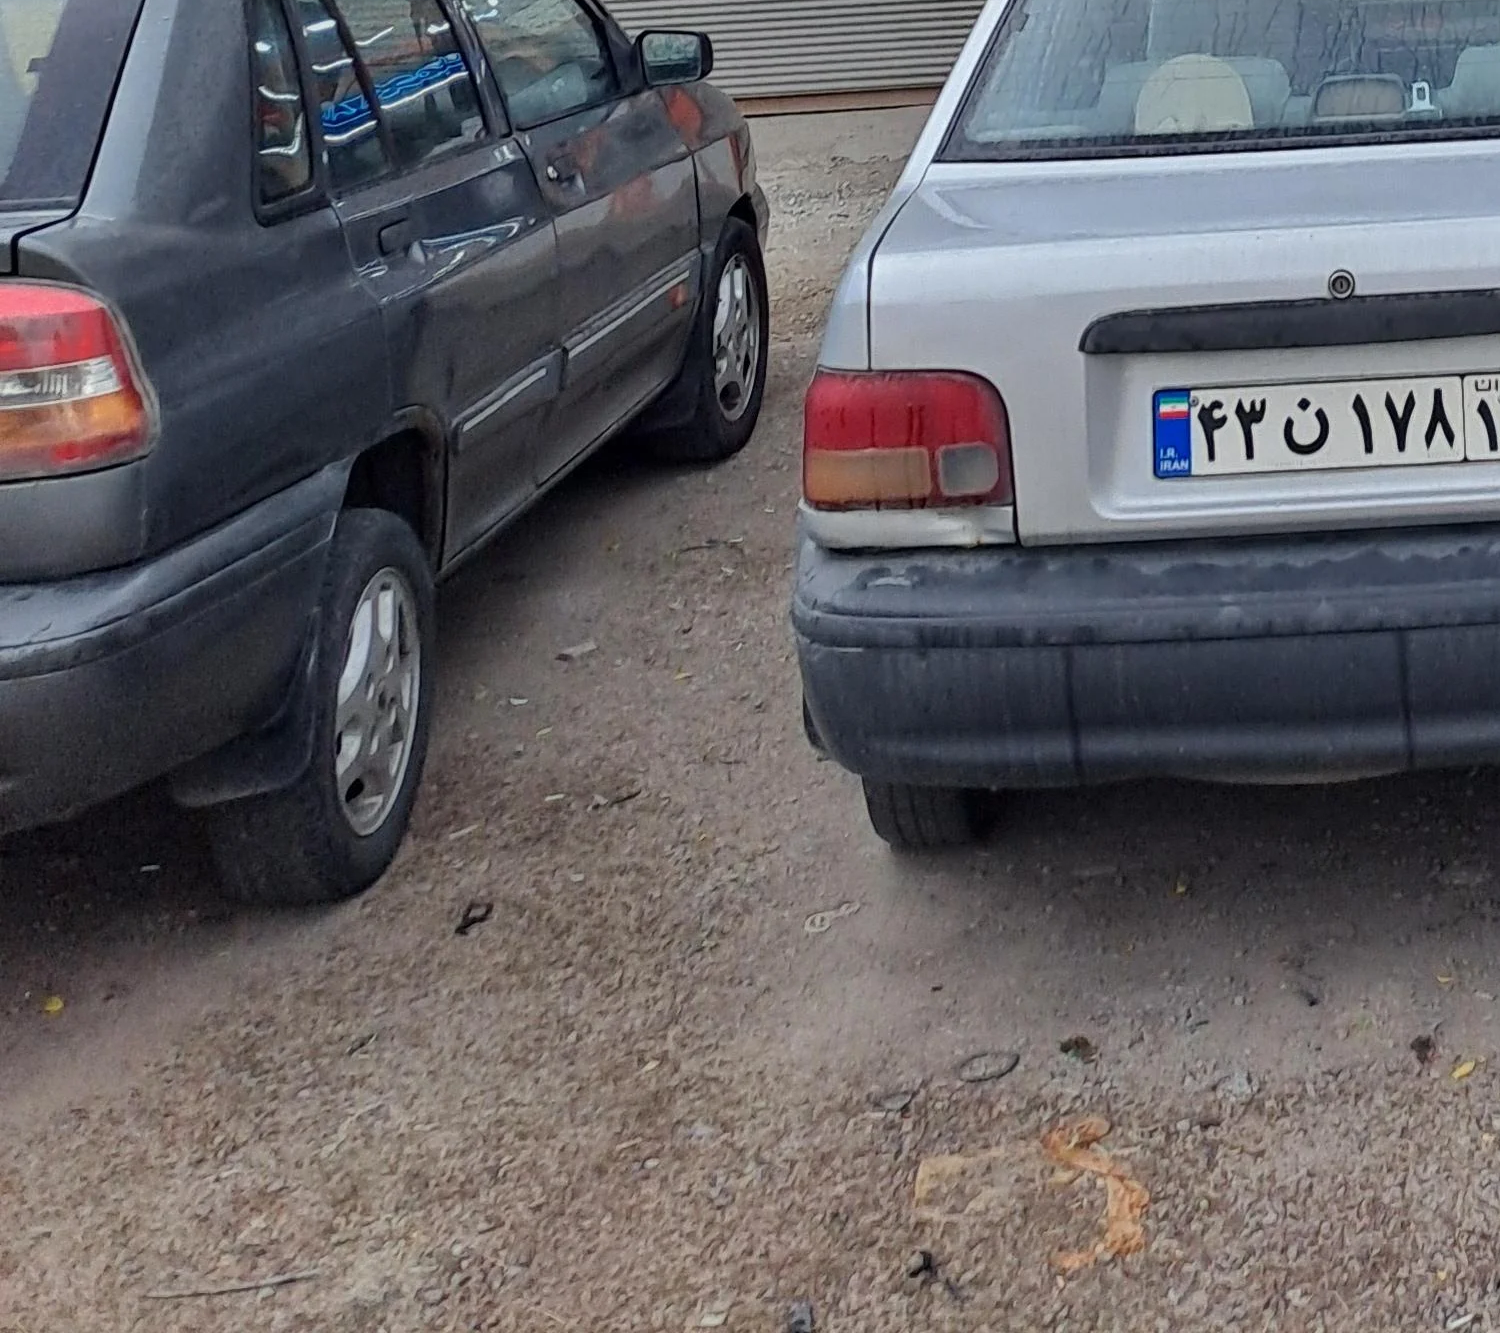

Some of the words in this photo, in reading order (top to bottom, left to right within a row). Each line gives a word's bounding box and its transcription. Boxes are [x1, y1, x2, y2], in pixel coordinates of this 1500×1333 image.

[1197, 397, 1268, 463] ۴۳
[1283, 397, 1331, 456] ن
[1351, 387, 1457, 455] ۱۷۸
[1159, 460, 1190, 472] IRAN
